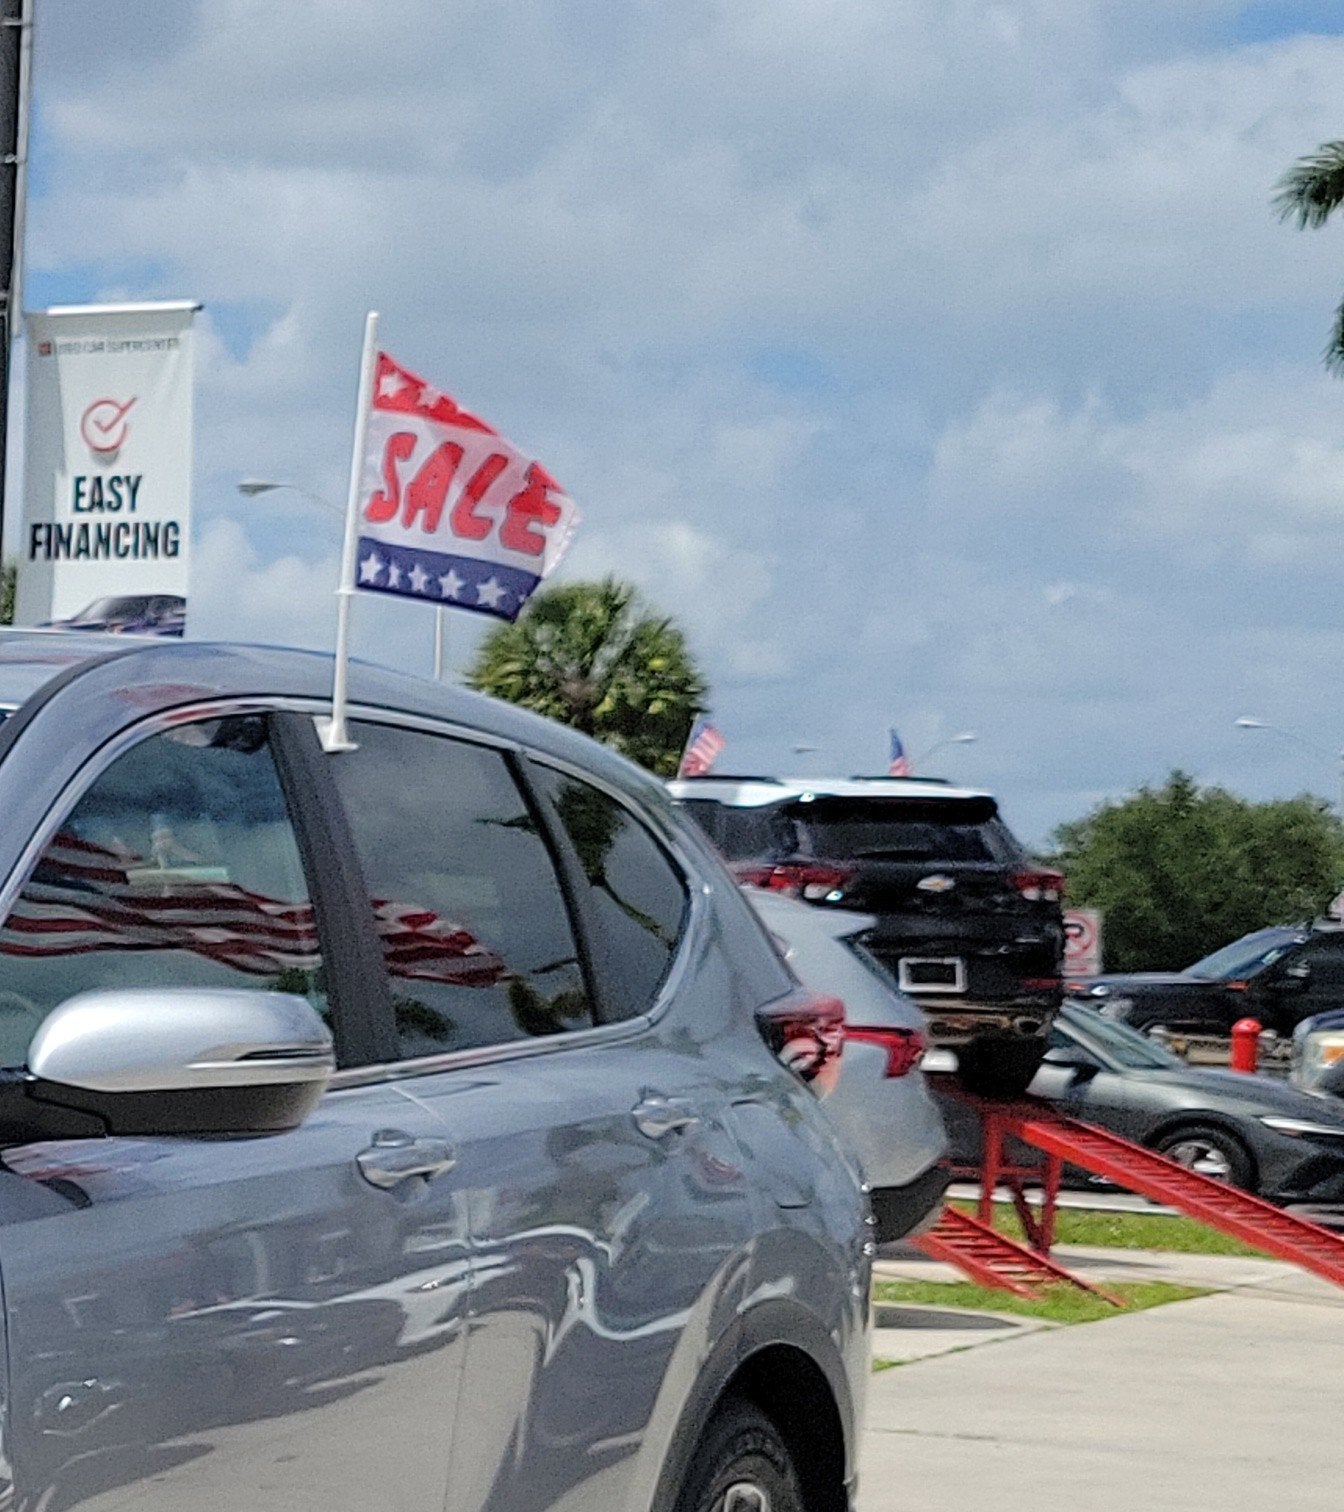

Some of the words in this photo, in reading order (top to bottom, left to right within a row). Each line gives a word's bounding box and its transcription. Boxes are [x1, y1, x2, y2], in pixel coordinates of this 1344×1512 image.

[72, 475, 144, 514] EASY
[364, 431, 562, 557] SALE
[28, 520, 181, 562] FINANCING
